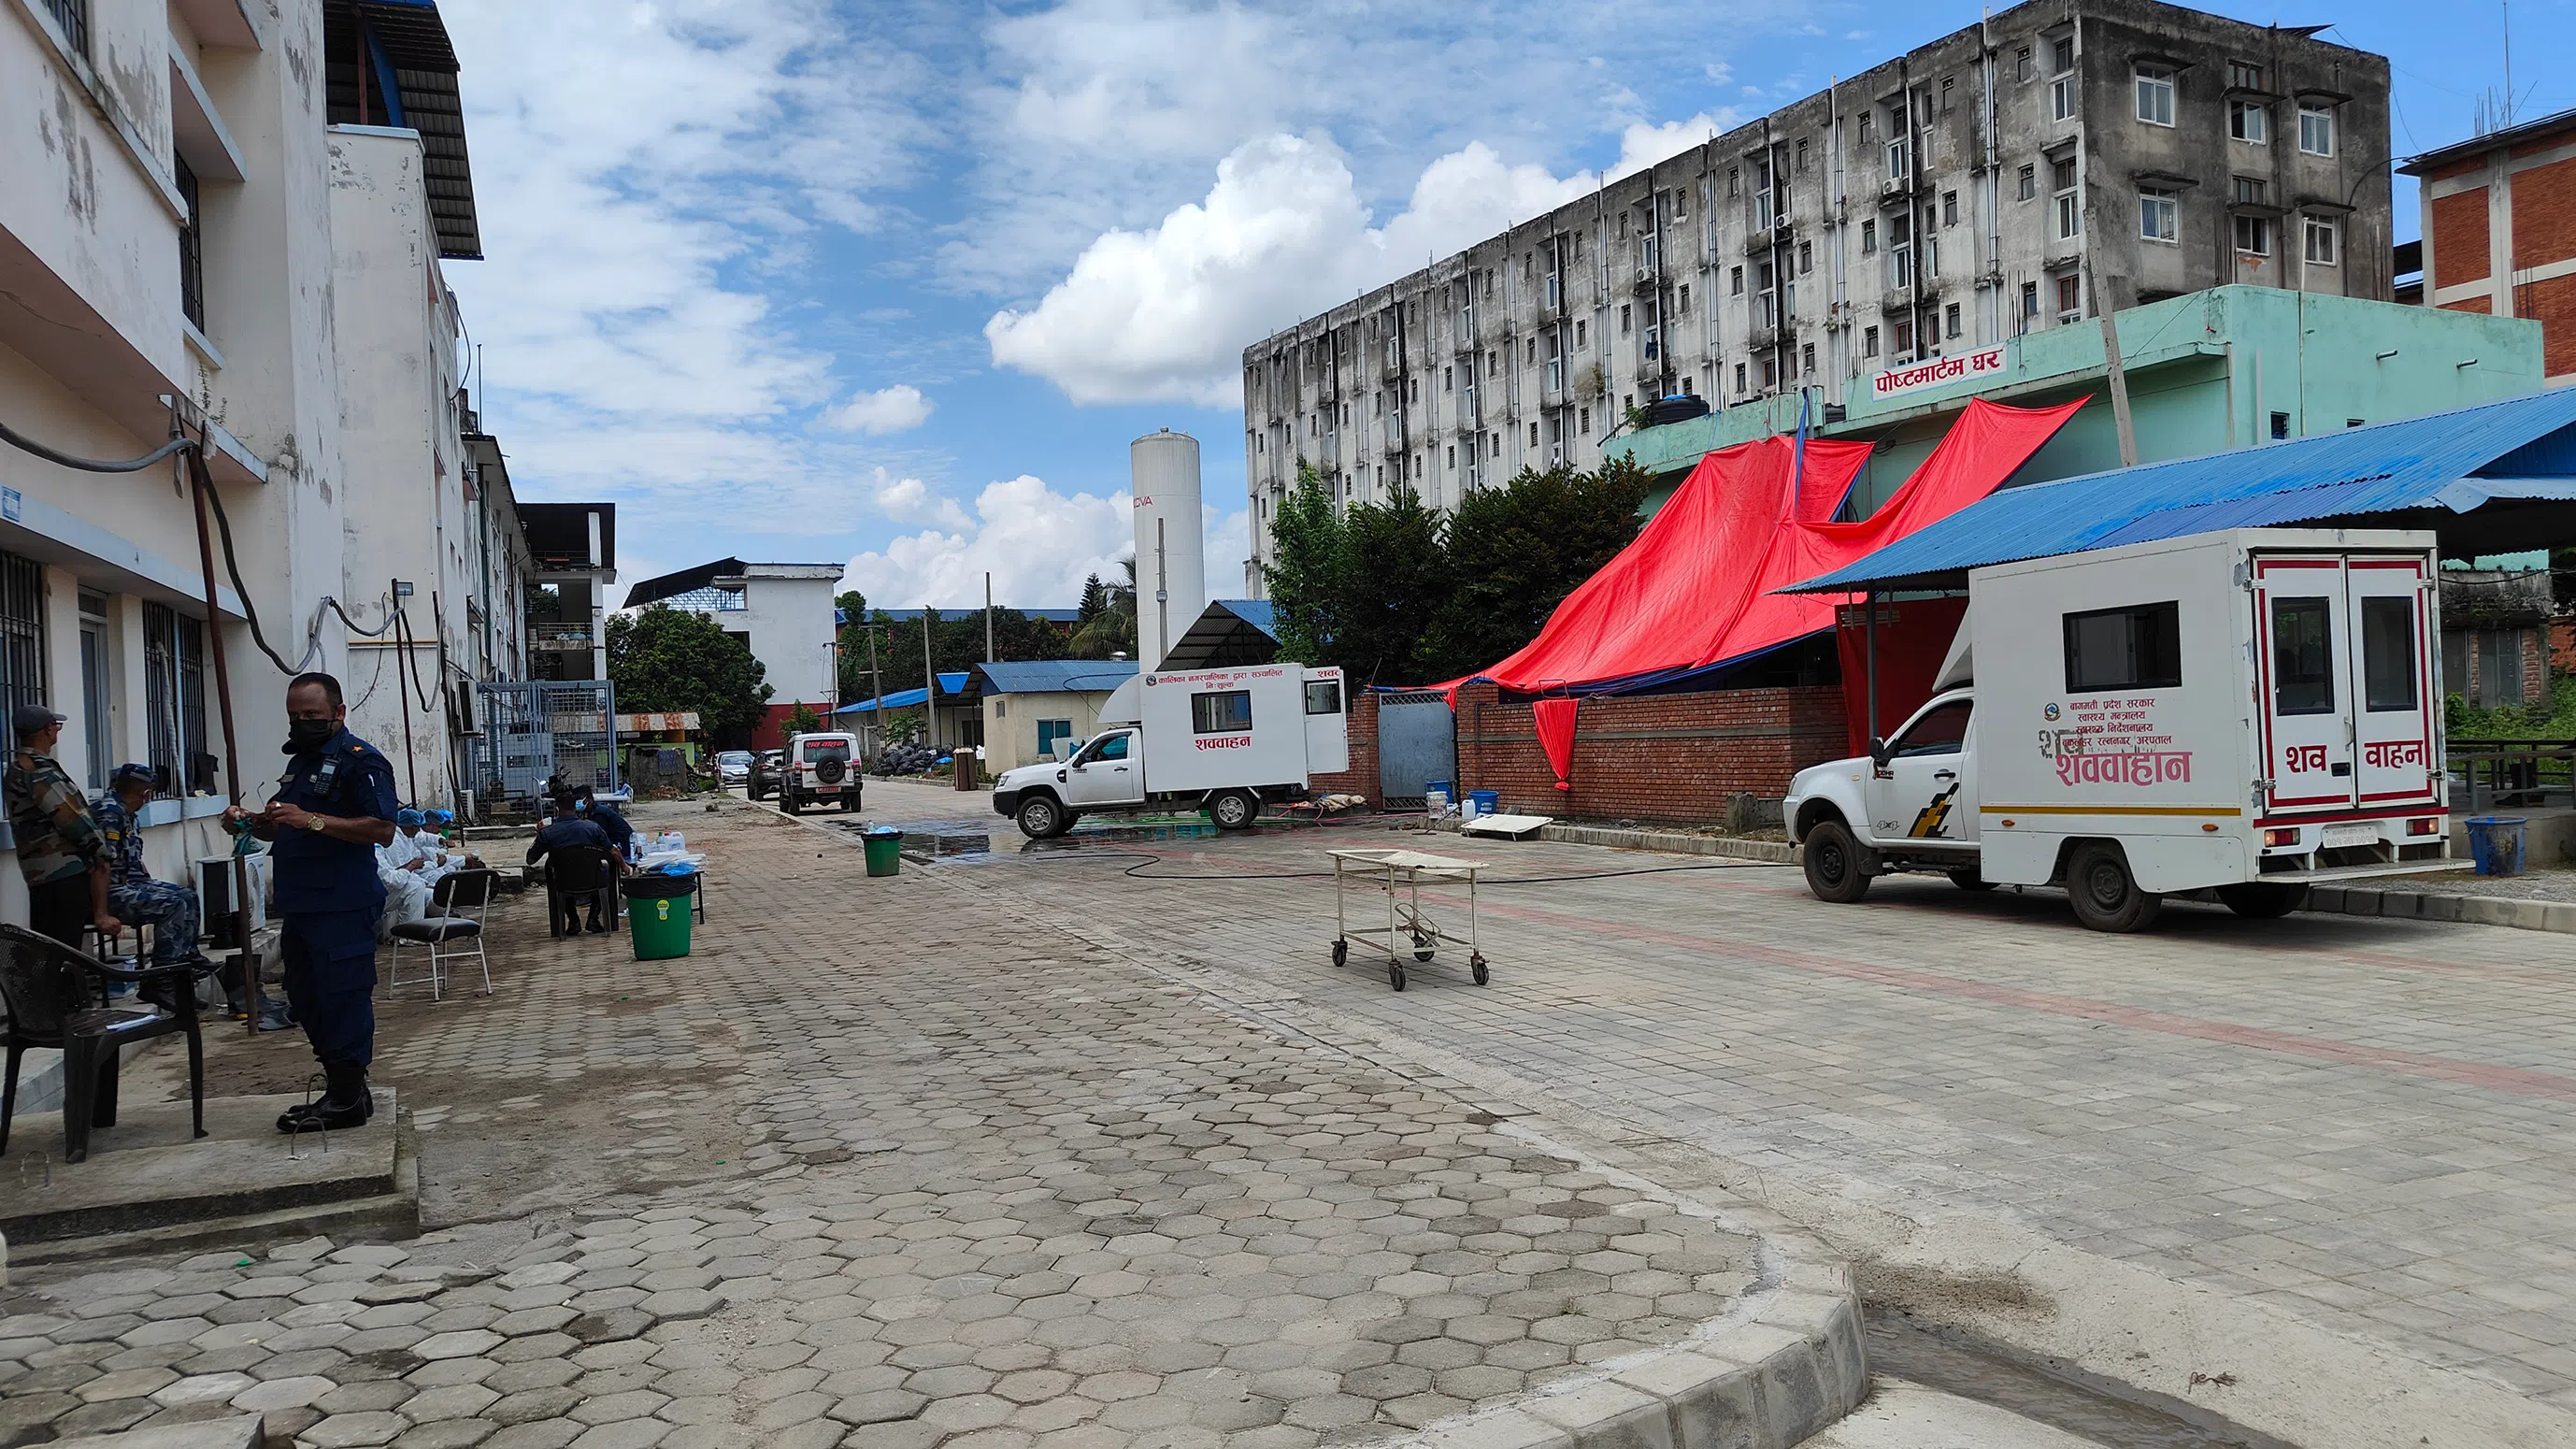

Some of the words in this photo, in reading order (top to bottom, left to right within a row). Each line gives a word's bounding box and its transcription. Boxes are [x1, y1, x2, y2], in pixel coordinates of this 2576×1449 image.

[1875, 356, 1965, 392] पोष्टमार्टम
[1971, 350, 2002, 370] घर
[1159, 675, 1185, 684] कालिका
[1188, 672, 1228, 682] नगरपालिका
[1233, 672, 1247, 681] द्वारा
[2069, 699, 2097, 710] बागमती
[2103, 699, 2122, 710] प्रदेश
[2126, 697, 2155, 708] सरकार
[2078, 712, 2105, 722] स्वास्थ्य
[2110, 710, 2146, 721] मन्त्रालय
[2107, 722, 2154, 733] निर्देशनालय
[1195, 736, 1252, 751] शववाहन
[2137, 735, 2172, 746] अस्पताल
[2285, 745, 2327, 773] शव
[2364, 739, 2424, 769] वाहन
